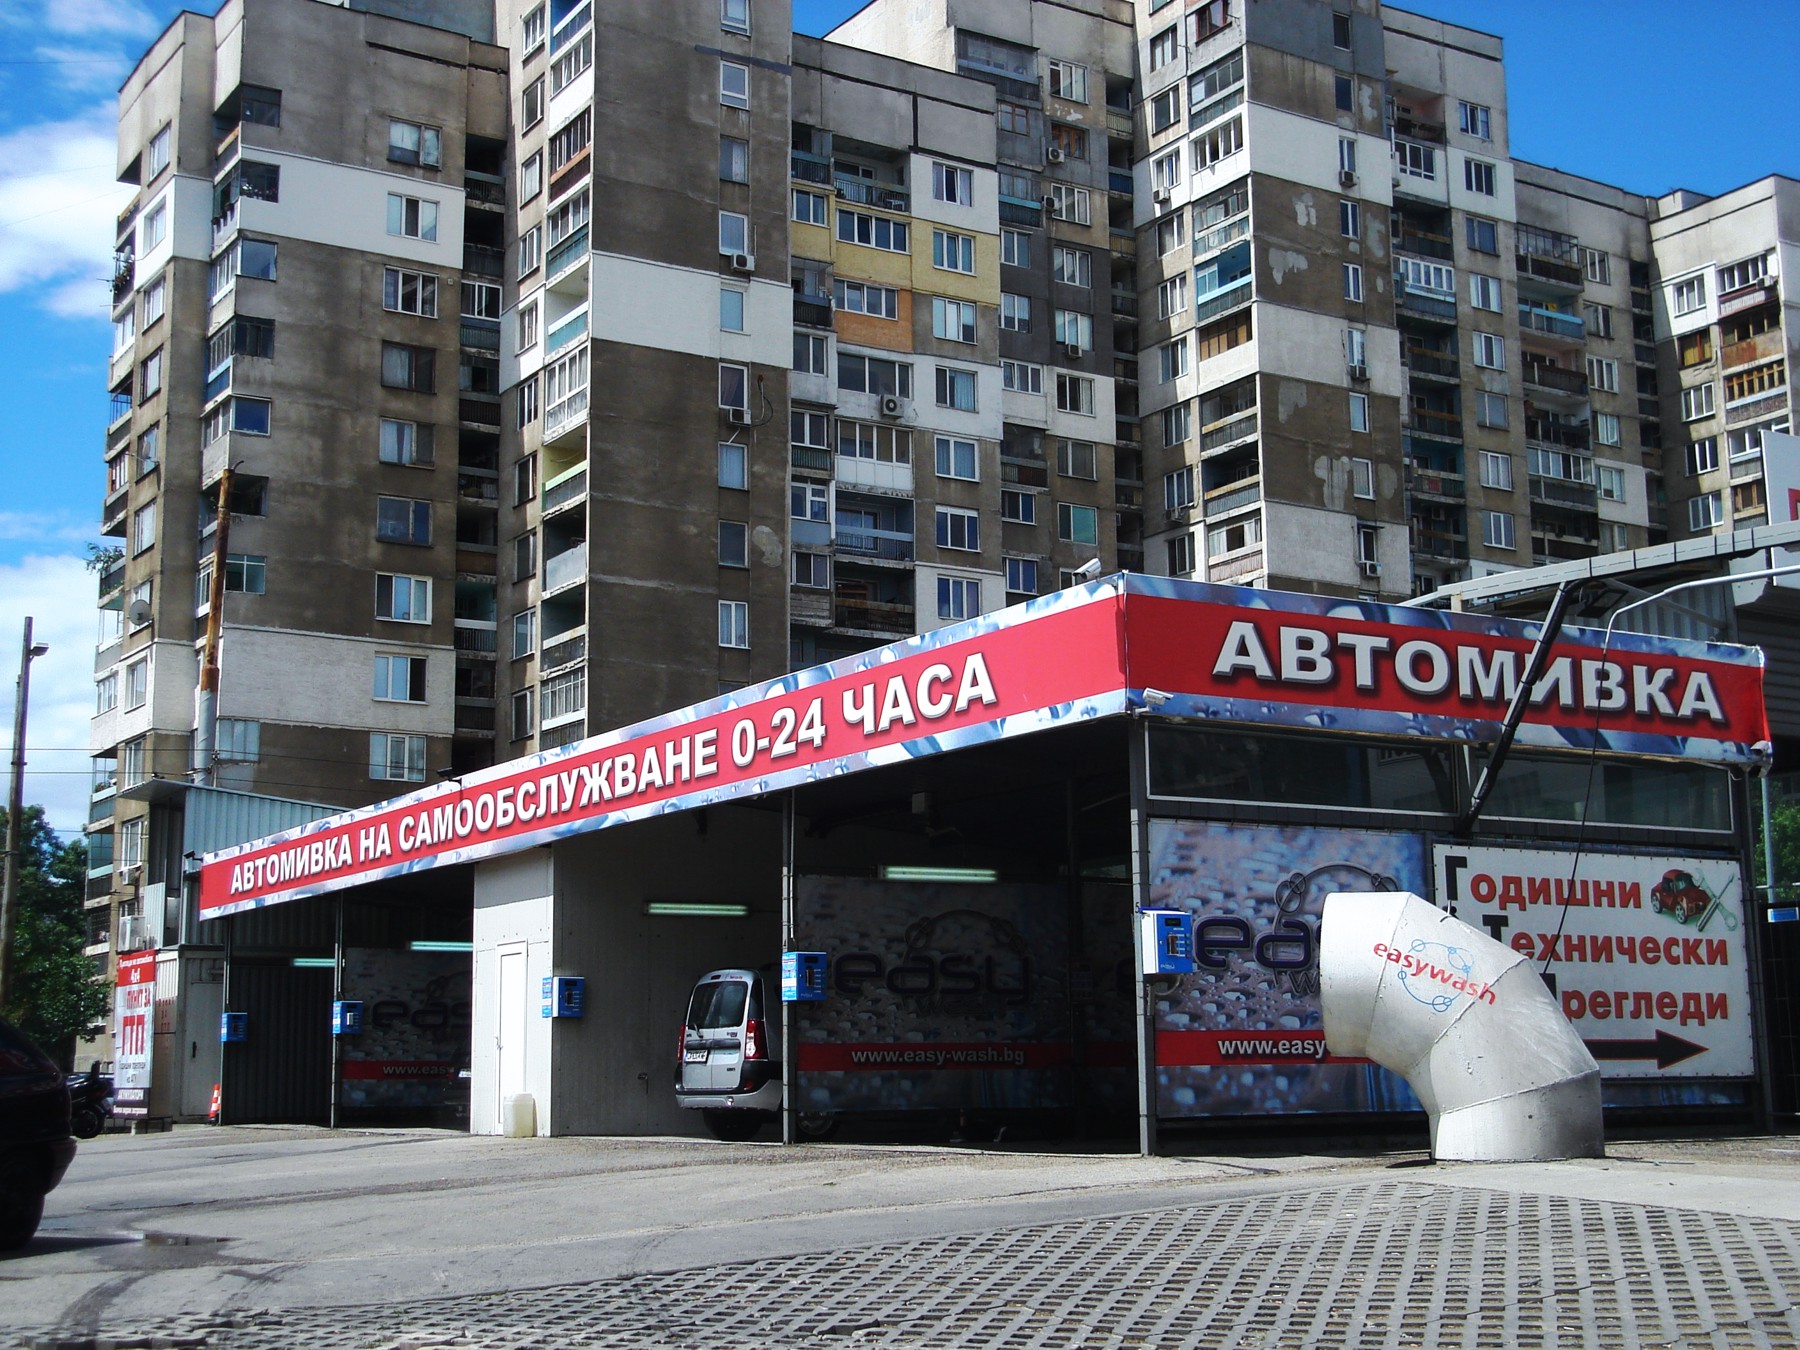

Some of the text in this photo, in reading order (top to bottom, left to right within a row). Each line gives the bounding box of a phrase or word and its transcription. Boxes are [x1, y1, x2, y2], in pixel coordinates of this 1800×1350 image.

[1212, 620, 1726, 722] АВТОМИВКА
[230, 652, 998, 895] АВТОМИВКА НА САМООБСЛУЖВАНЕ 0-24 ЧАСА
[1444, 855, 1642, 911] Годишни
[1482, 914, 1728, 966] Технически
[1373, 942, 1498, 1006] easywash
[851, 1047, 1025, 1066] www.easy-wash.bg
